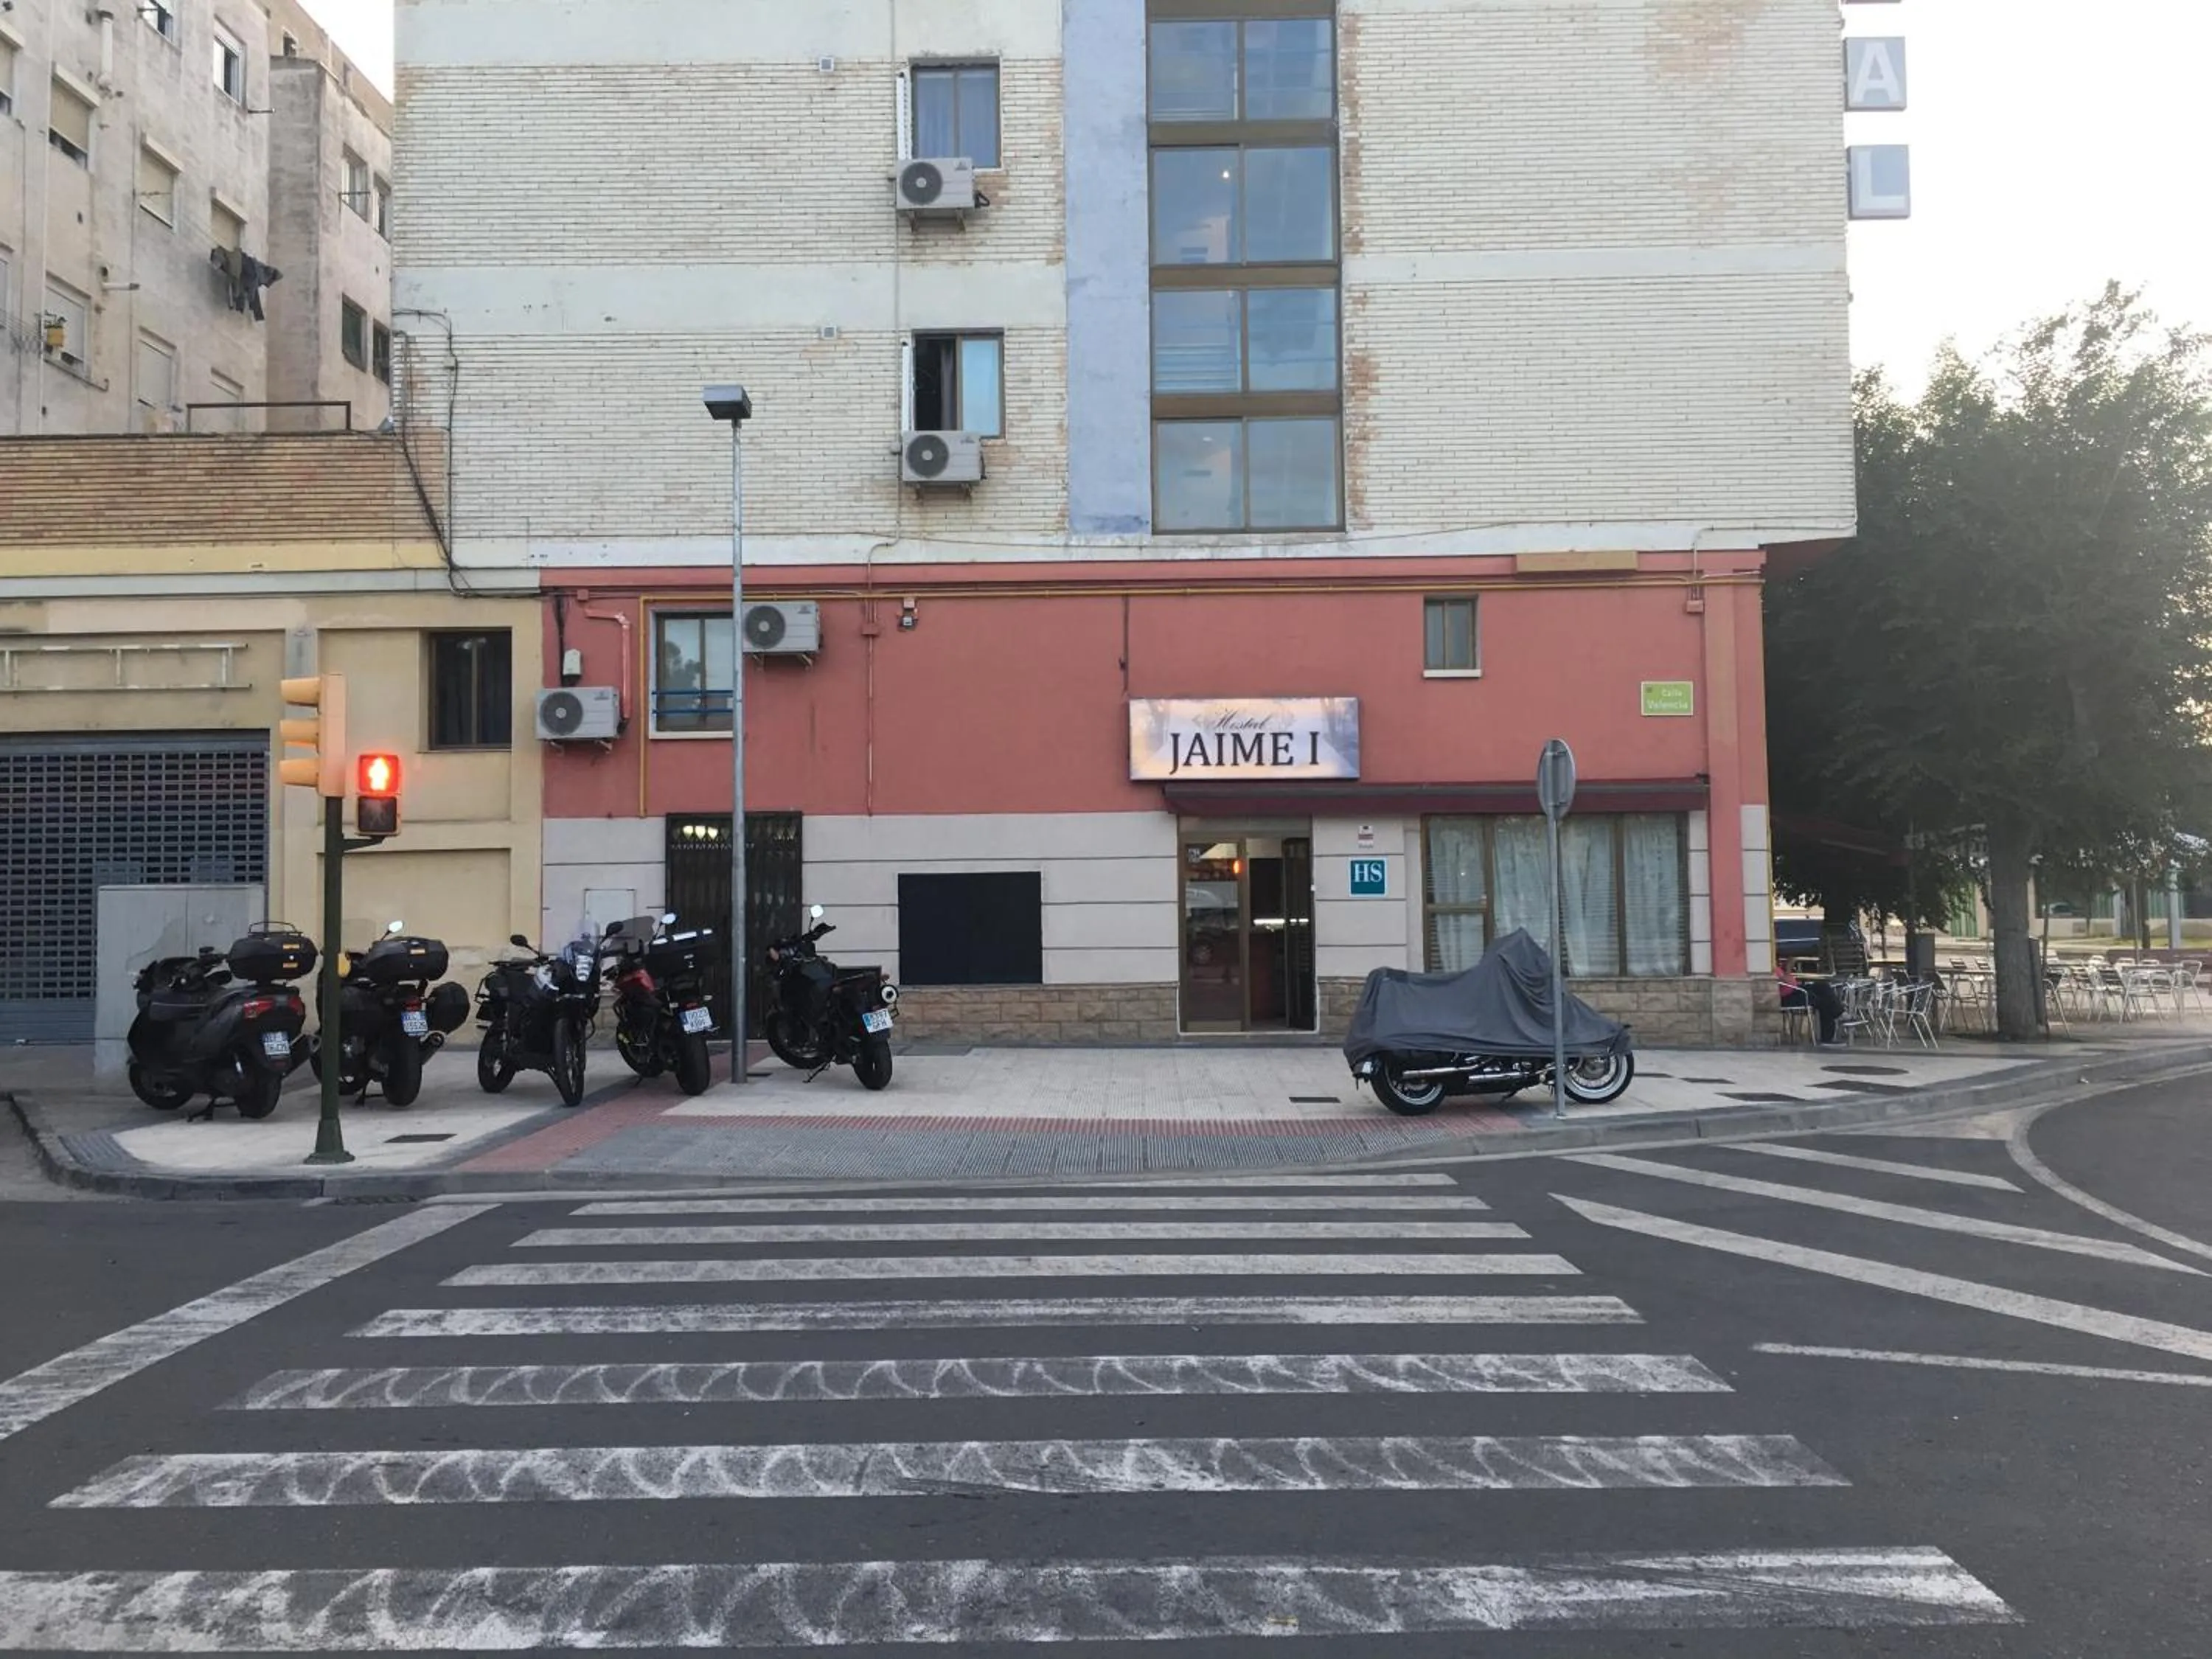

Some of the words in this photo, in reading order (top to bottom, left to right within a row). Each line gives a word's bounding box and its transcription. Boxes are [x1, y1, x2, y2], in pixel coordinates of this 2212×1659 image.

[1169, 732, 1294, 775] JAIME
[1309, 731, 1320, 765] I
[1354, 862, 1383, 883] HS
